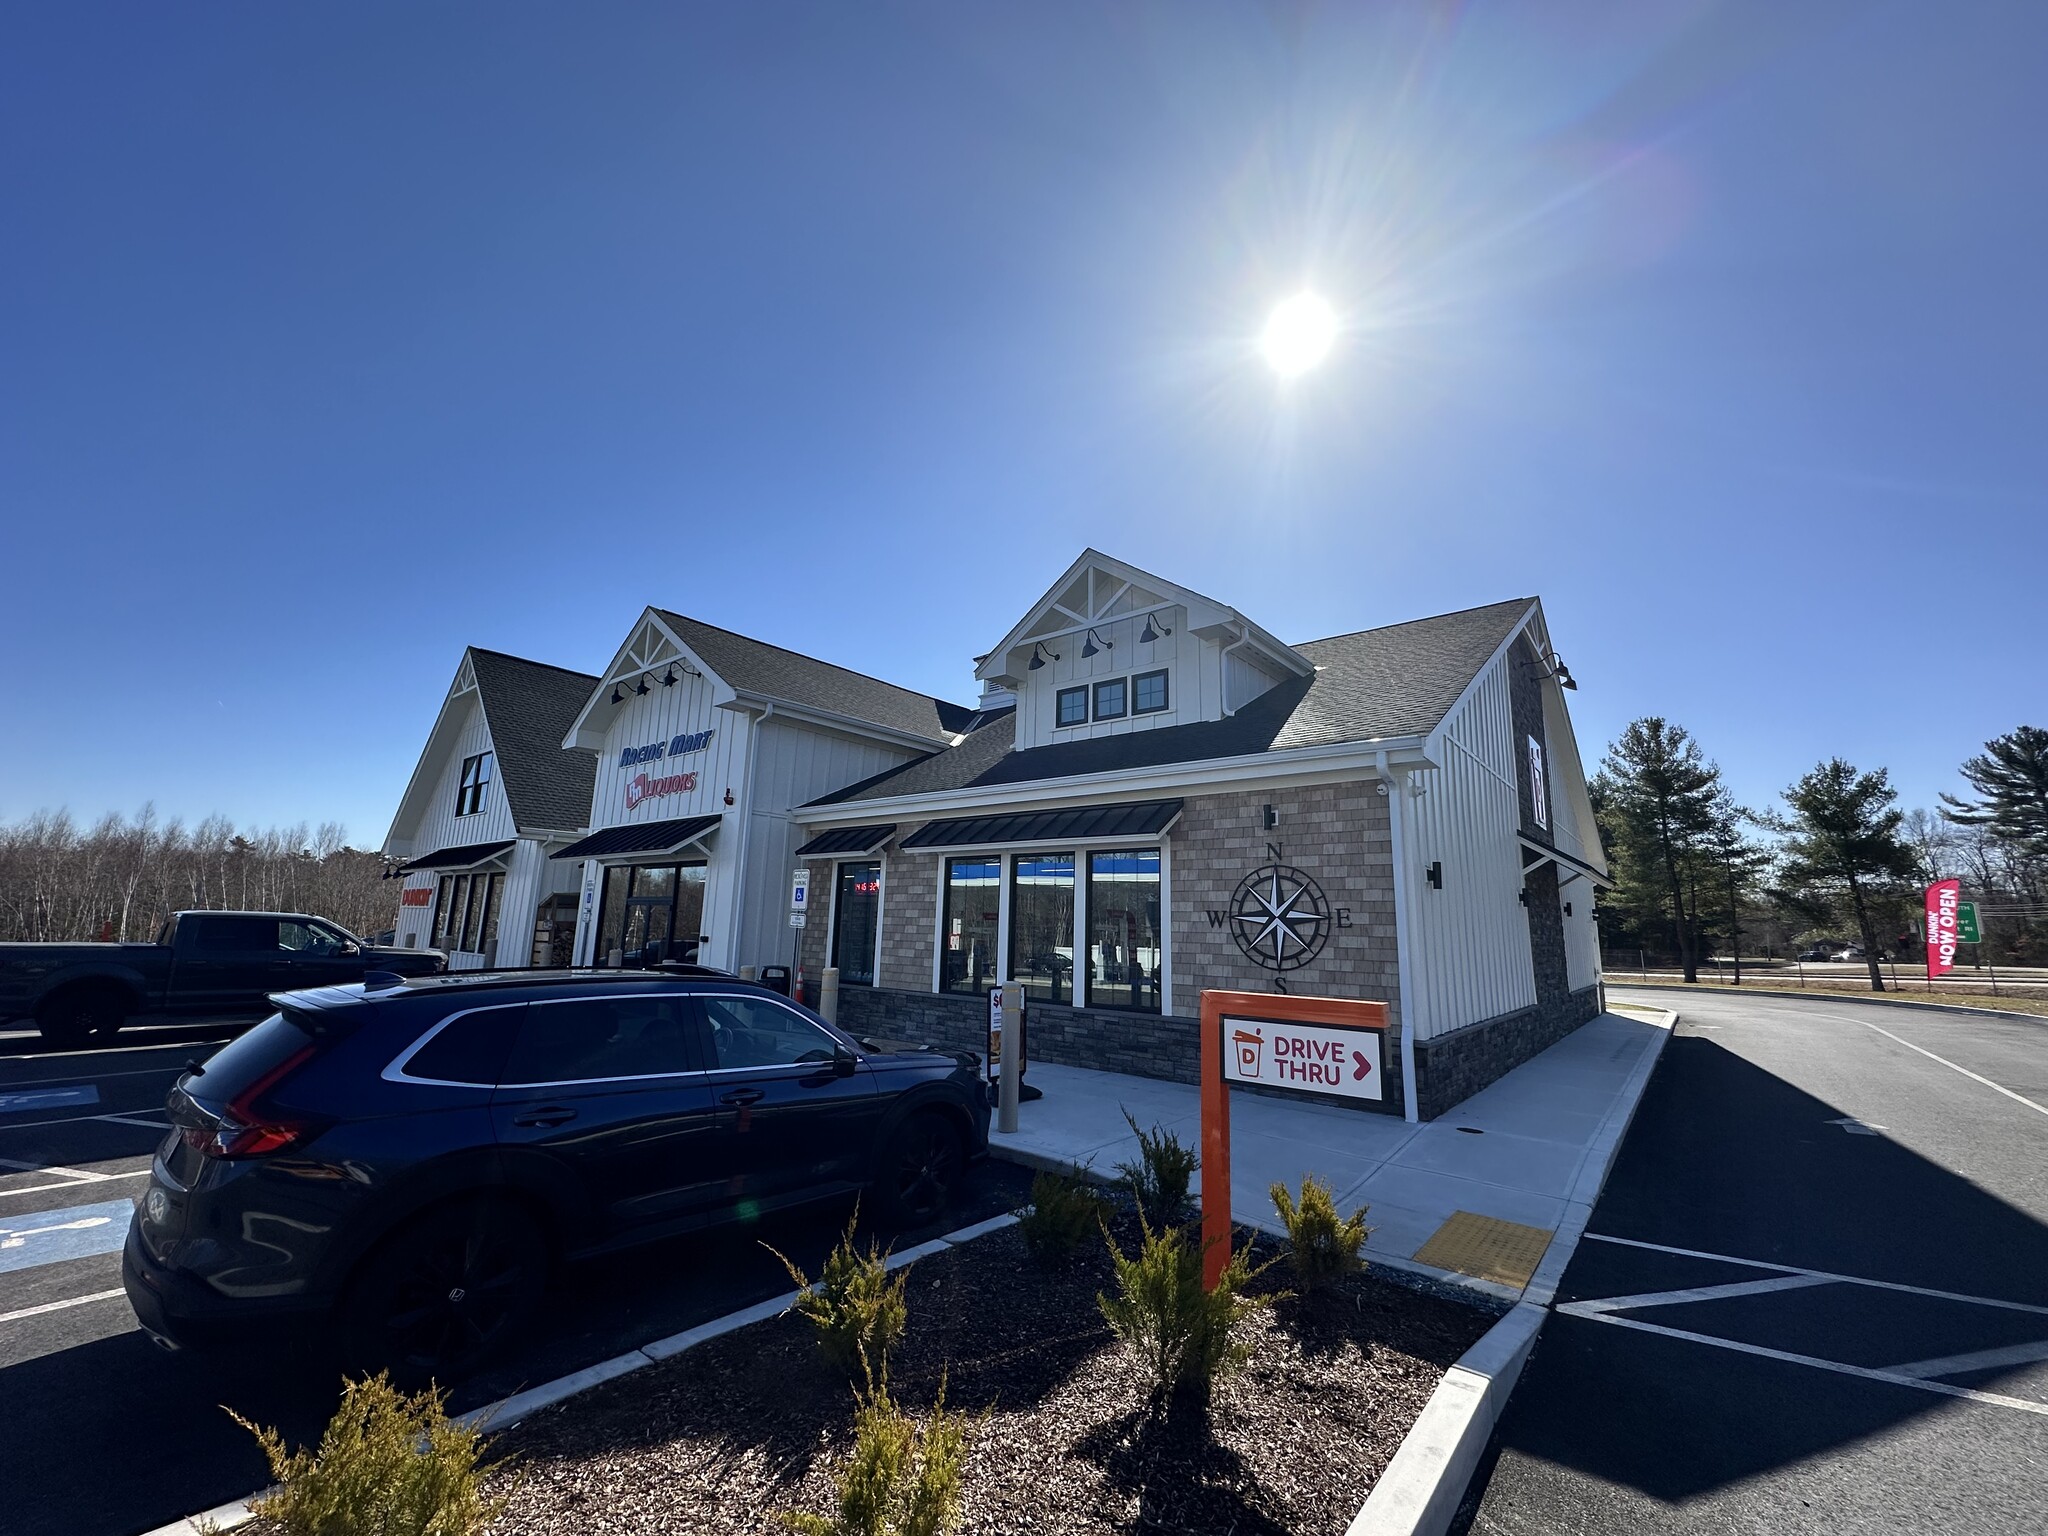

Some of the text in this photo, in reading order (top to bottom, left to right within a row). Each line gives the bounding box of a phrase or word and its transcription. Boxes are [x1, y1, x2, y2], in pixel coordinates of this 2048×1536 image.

[645, 771, 697, 798] LIQUORS
[1265, 842, 1283, 861] N
[1206, 908, 1353, 929] W E
[1939, 888, 1956, 966] NOW OPEN
[1274, 977, 1287, 995] S
[1274, 1036, 1346, 1063] DRIVE
[1274, 1058, 1341, 1086] THRU
